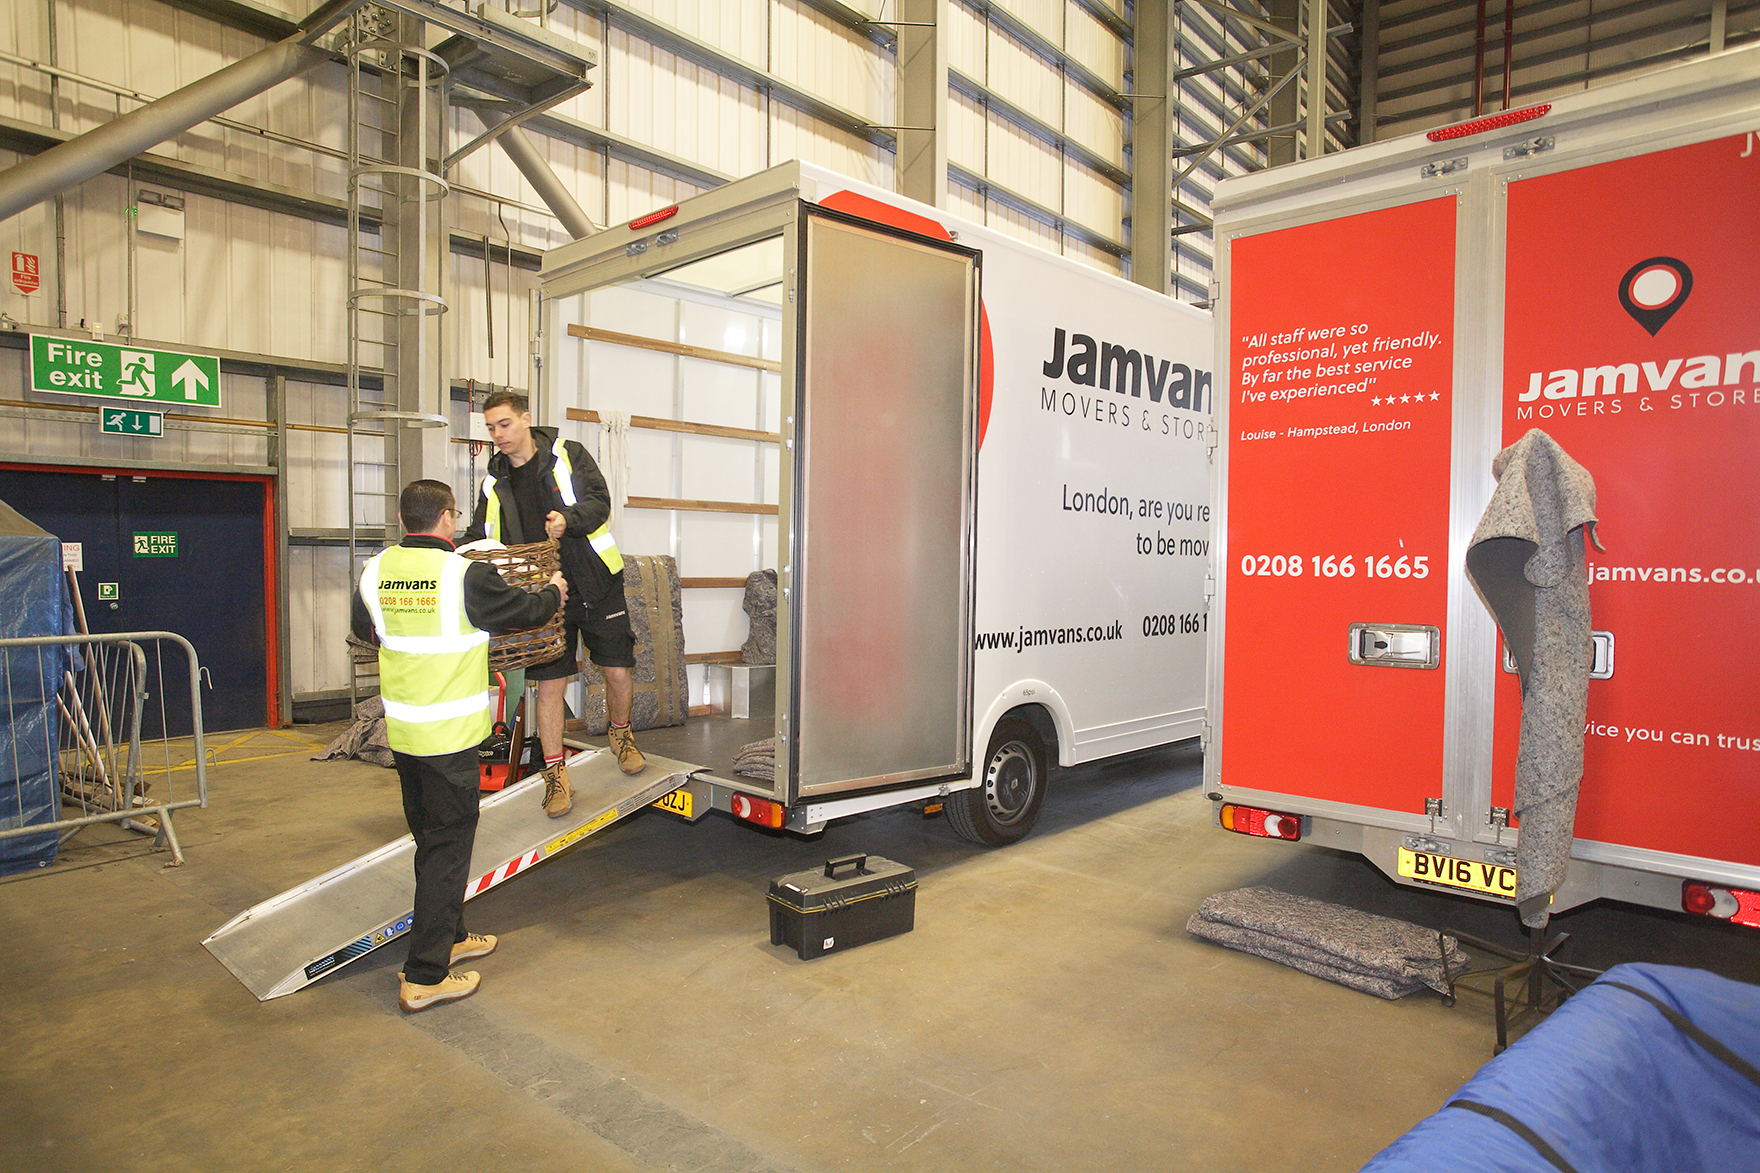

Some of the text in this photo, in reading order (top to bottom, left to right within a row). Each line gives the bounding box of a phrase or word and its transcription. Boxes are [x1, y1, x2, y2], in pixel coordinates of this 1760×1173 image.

[1242, 324, 1368, 348] "All staff were so
[48, 342, 103, 368] Fire
[1242, 331, 1442, 372] professional, yet friendly.
[49, 369, 103, 390] exit
[1242, 356, 1412, 388] By far the best service
[1241, 378, 1376, 404] I've experienced"
[1042, 387, 1130, 427] MOVERS
[1142, 410, 1152, 431] &
[1517, 400, 1622, 420] MOVERS
[1639, 397, 1654, 412] &
[1240, 429, 1276, 441] Louise
[1288, 422, 1359, 438] Hampstead,
[1362, 419, 1411, 433] London
[1062, 484, 1134, 520] London,
[1138, 498, 1163, 518] are
[1167, 502, 1192, 526] you
[150, 535, 176, 544] FIRE
[150, 546, 176, 554] EXIT
[1136, 530, 1210, 556] to be mov
[1241, 554, 1430, 579] 0208 166 1665
[1588, 562, 1760, 585] jamvans.co.
[380, 597, 436, 606] 0208 166 1665
[975, 620, 1123, 654] www.jamvans.co.uk
[1142, 614, 1176, 638] 0208
[1180, 613, 1200, 634] 166
[1625, 727, 1664, 742] you
[1670, 731, 1710, 746] can
[1415, 853, 1471, 883] BV16
[1482, 865, 1515, 891] VC
